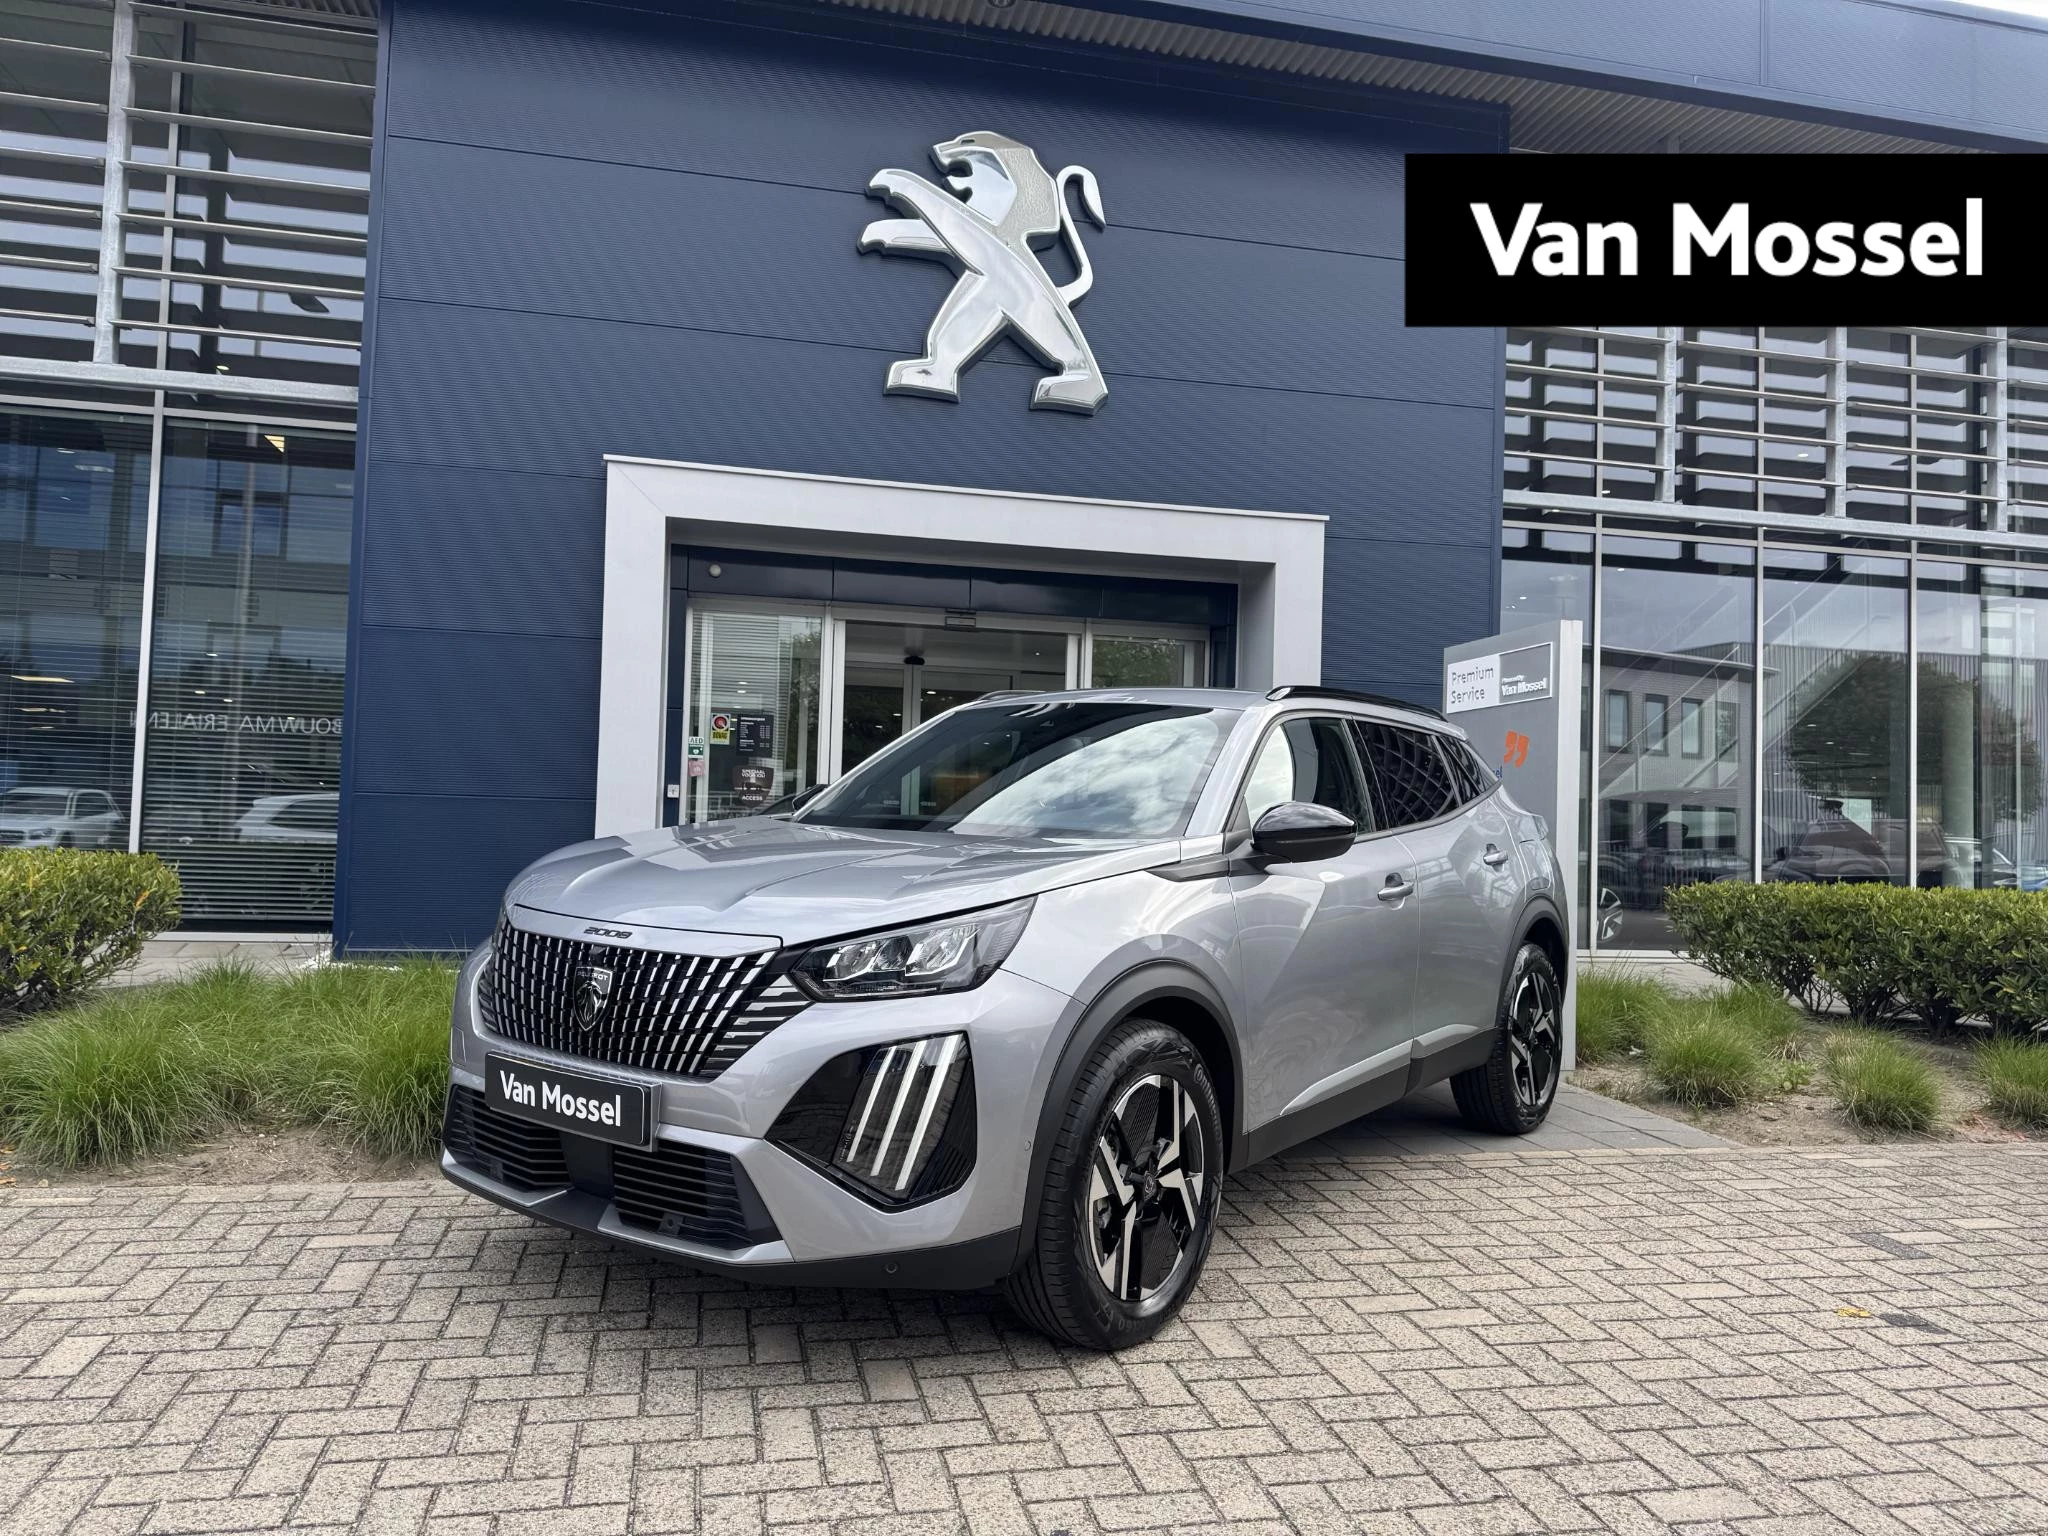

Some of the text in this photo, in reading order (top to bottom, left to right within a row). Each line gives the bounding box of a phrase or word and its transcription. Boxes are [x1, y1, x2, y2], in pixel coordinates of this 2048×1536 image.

[1451, 667, 1494, 686] Premium
[1450, 687, 1486, 704] Service
[1501, 684, 1517, 696] Van
[1517, 678, 1548, 693] Mossel
[584, 926, 633, 939] 2008
[499, 1070, 621, 1127] Van Mossel
